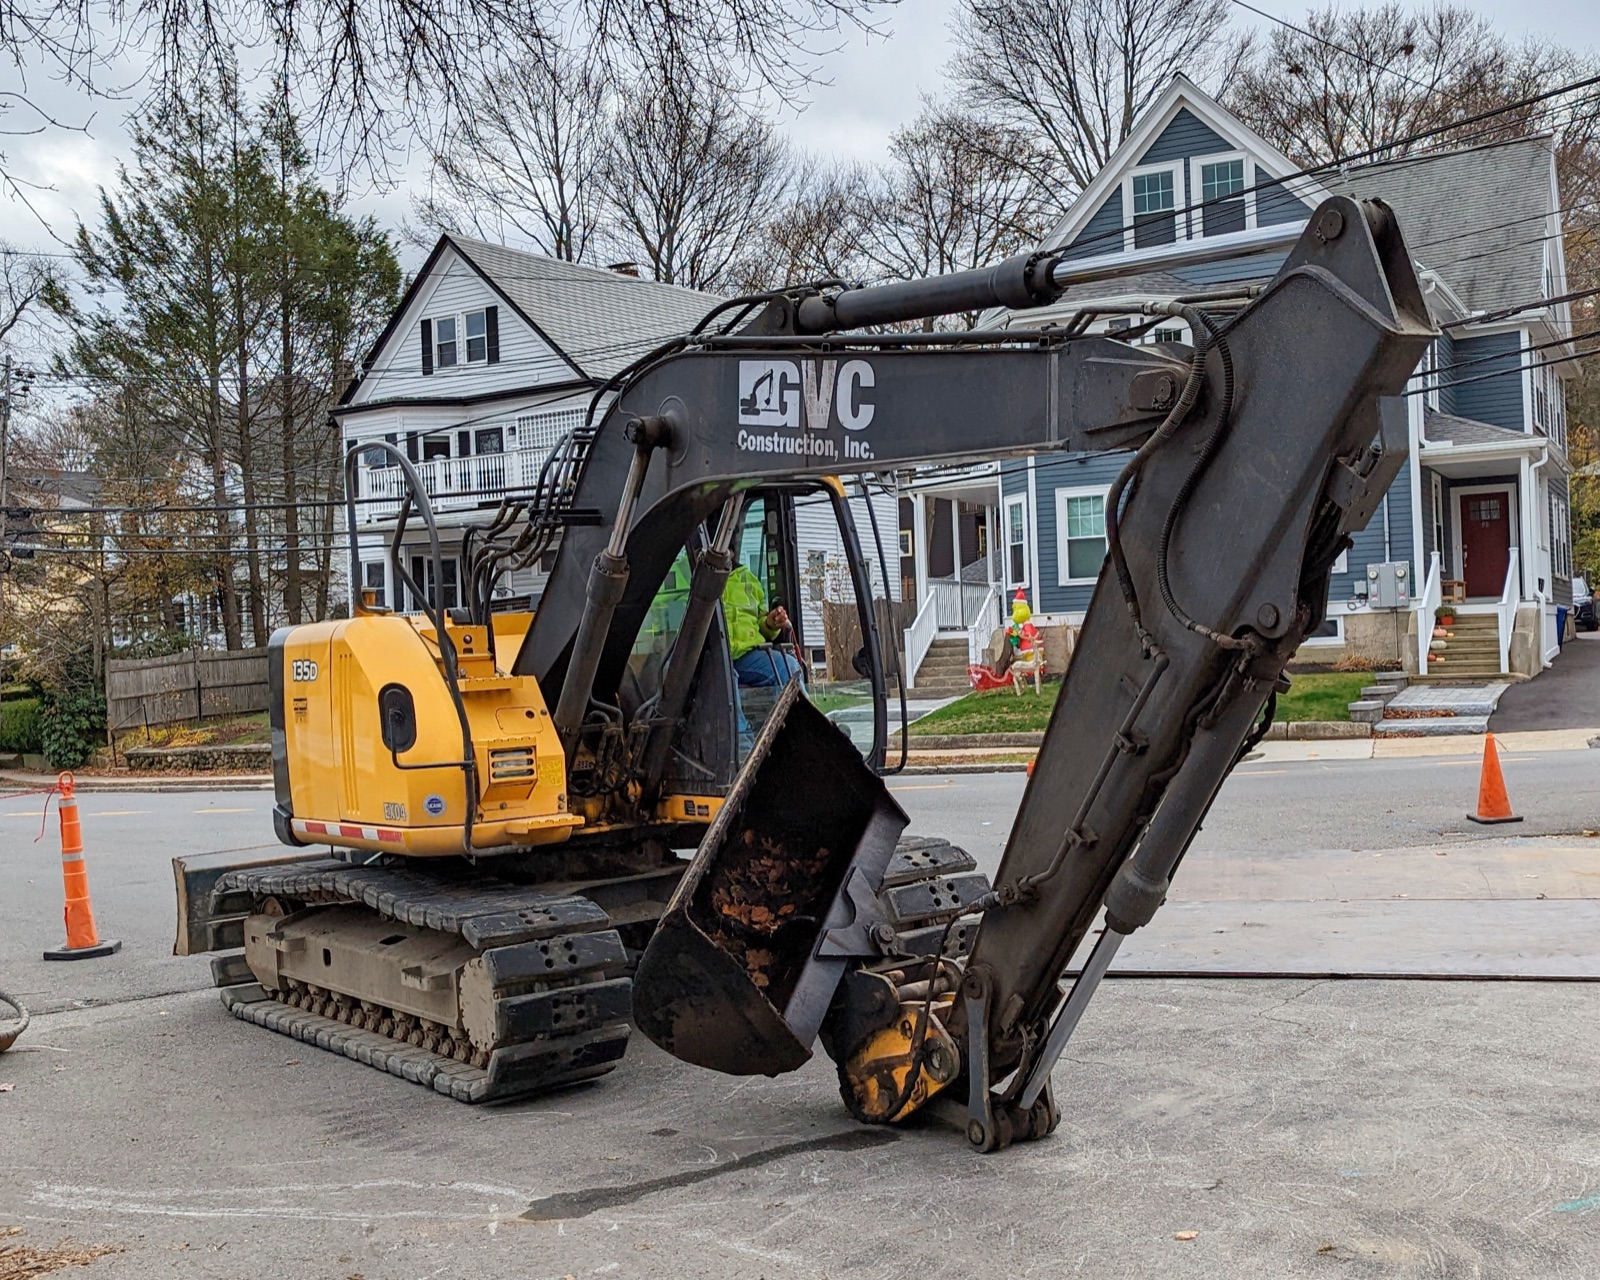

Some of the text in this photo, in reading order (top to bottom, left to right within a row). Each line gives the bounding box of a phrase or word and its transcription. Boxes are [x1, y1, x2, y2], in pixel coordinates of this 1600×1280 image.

[758, 359, 876, 431] GVC
[737, 429, 875, 462] Construction, Inc.
[292, 659, 318, 682] 135D
